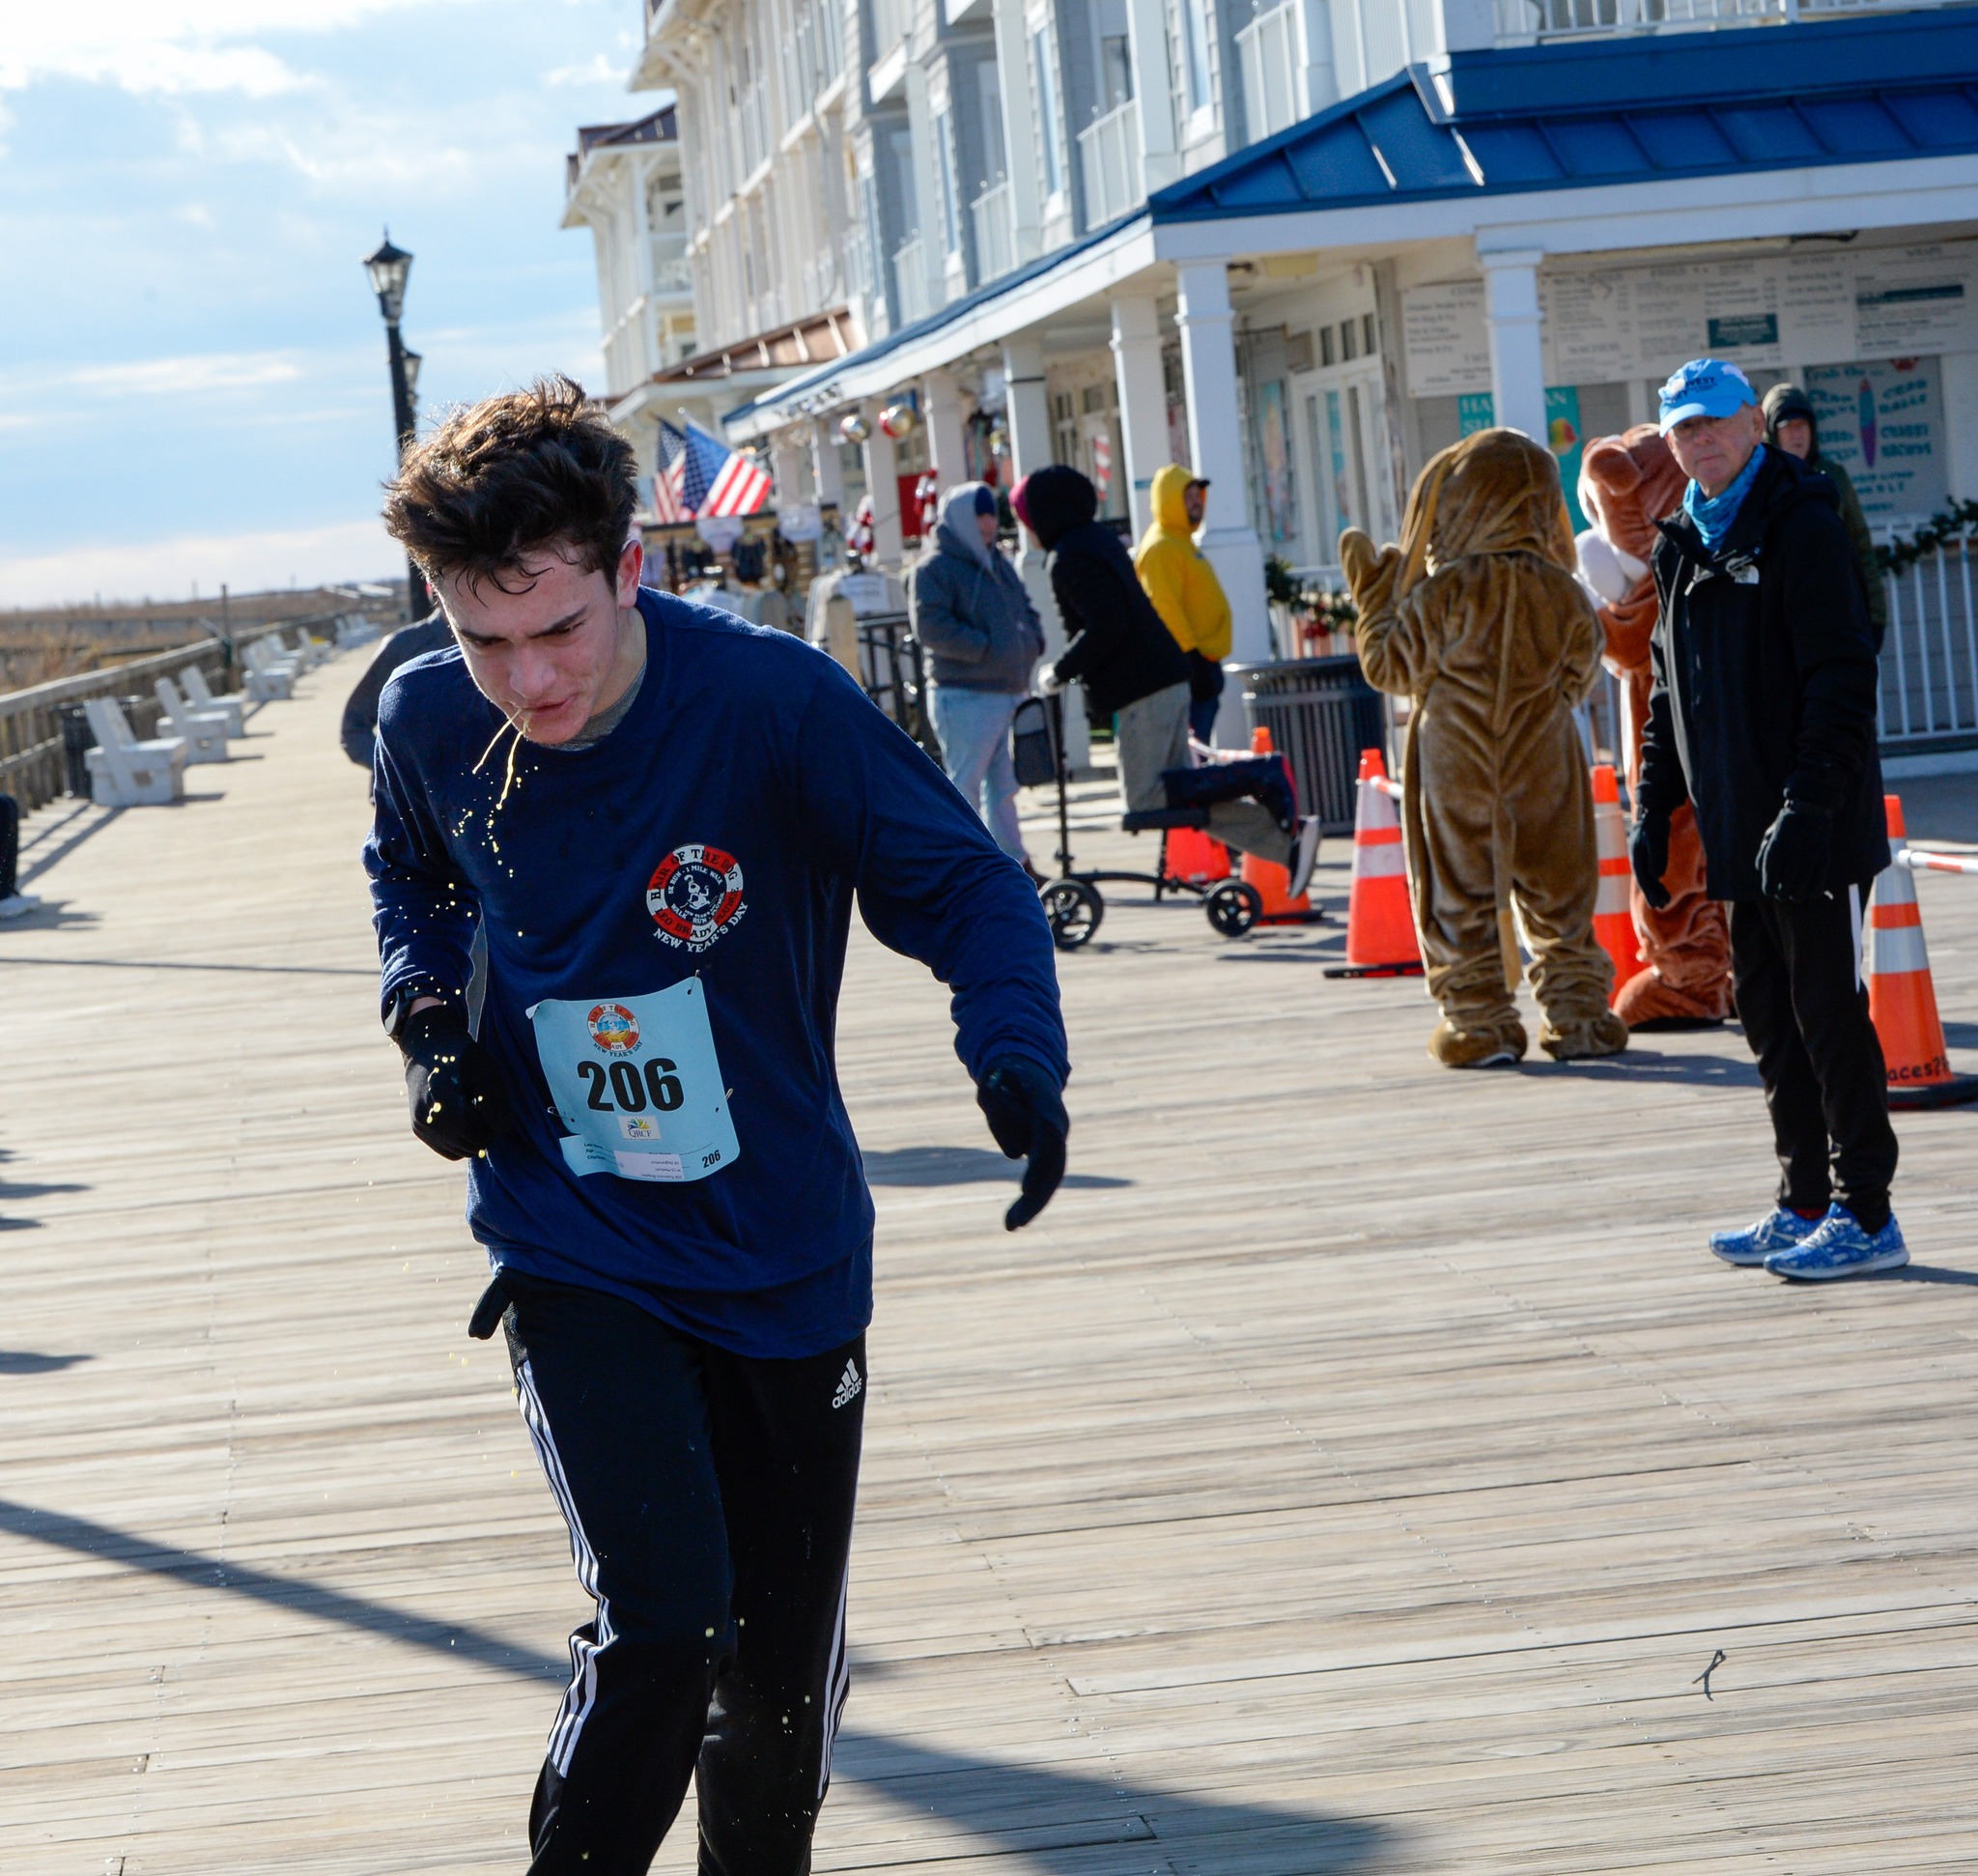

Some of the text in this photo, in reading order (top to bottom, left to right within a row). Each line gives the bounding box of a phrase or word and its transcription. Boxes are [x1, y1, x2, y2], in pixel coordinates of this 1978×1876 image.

[650, 848, 738, 900] HAIR OF THE DOG
[691, 865, 708, 874] MILE
[710, 870, 722, 885] WALK
[653, 901, 749, 952] NEW YEAR'S DAY
[655, 908, 672, 925] LEO
[675, 924, 713, 939] BRADY
[593, 1042, 607, 1054] NEW
[633, 1041, 643, 1051] DAY
[577, 1058, 684, 1113] 206
[629, 1129, 652, 1138] QRCF
[702, 1149, 721, 1169] 206
[832, 1378, 862, 1408] adidas
